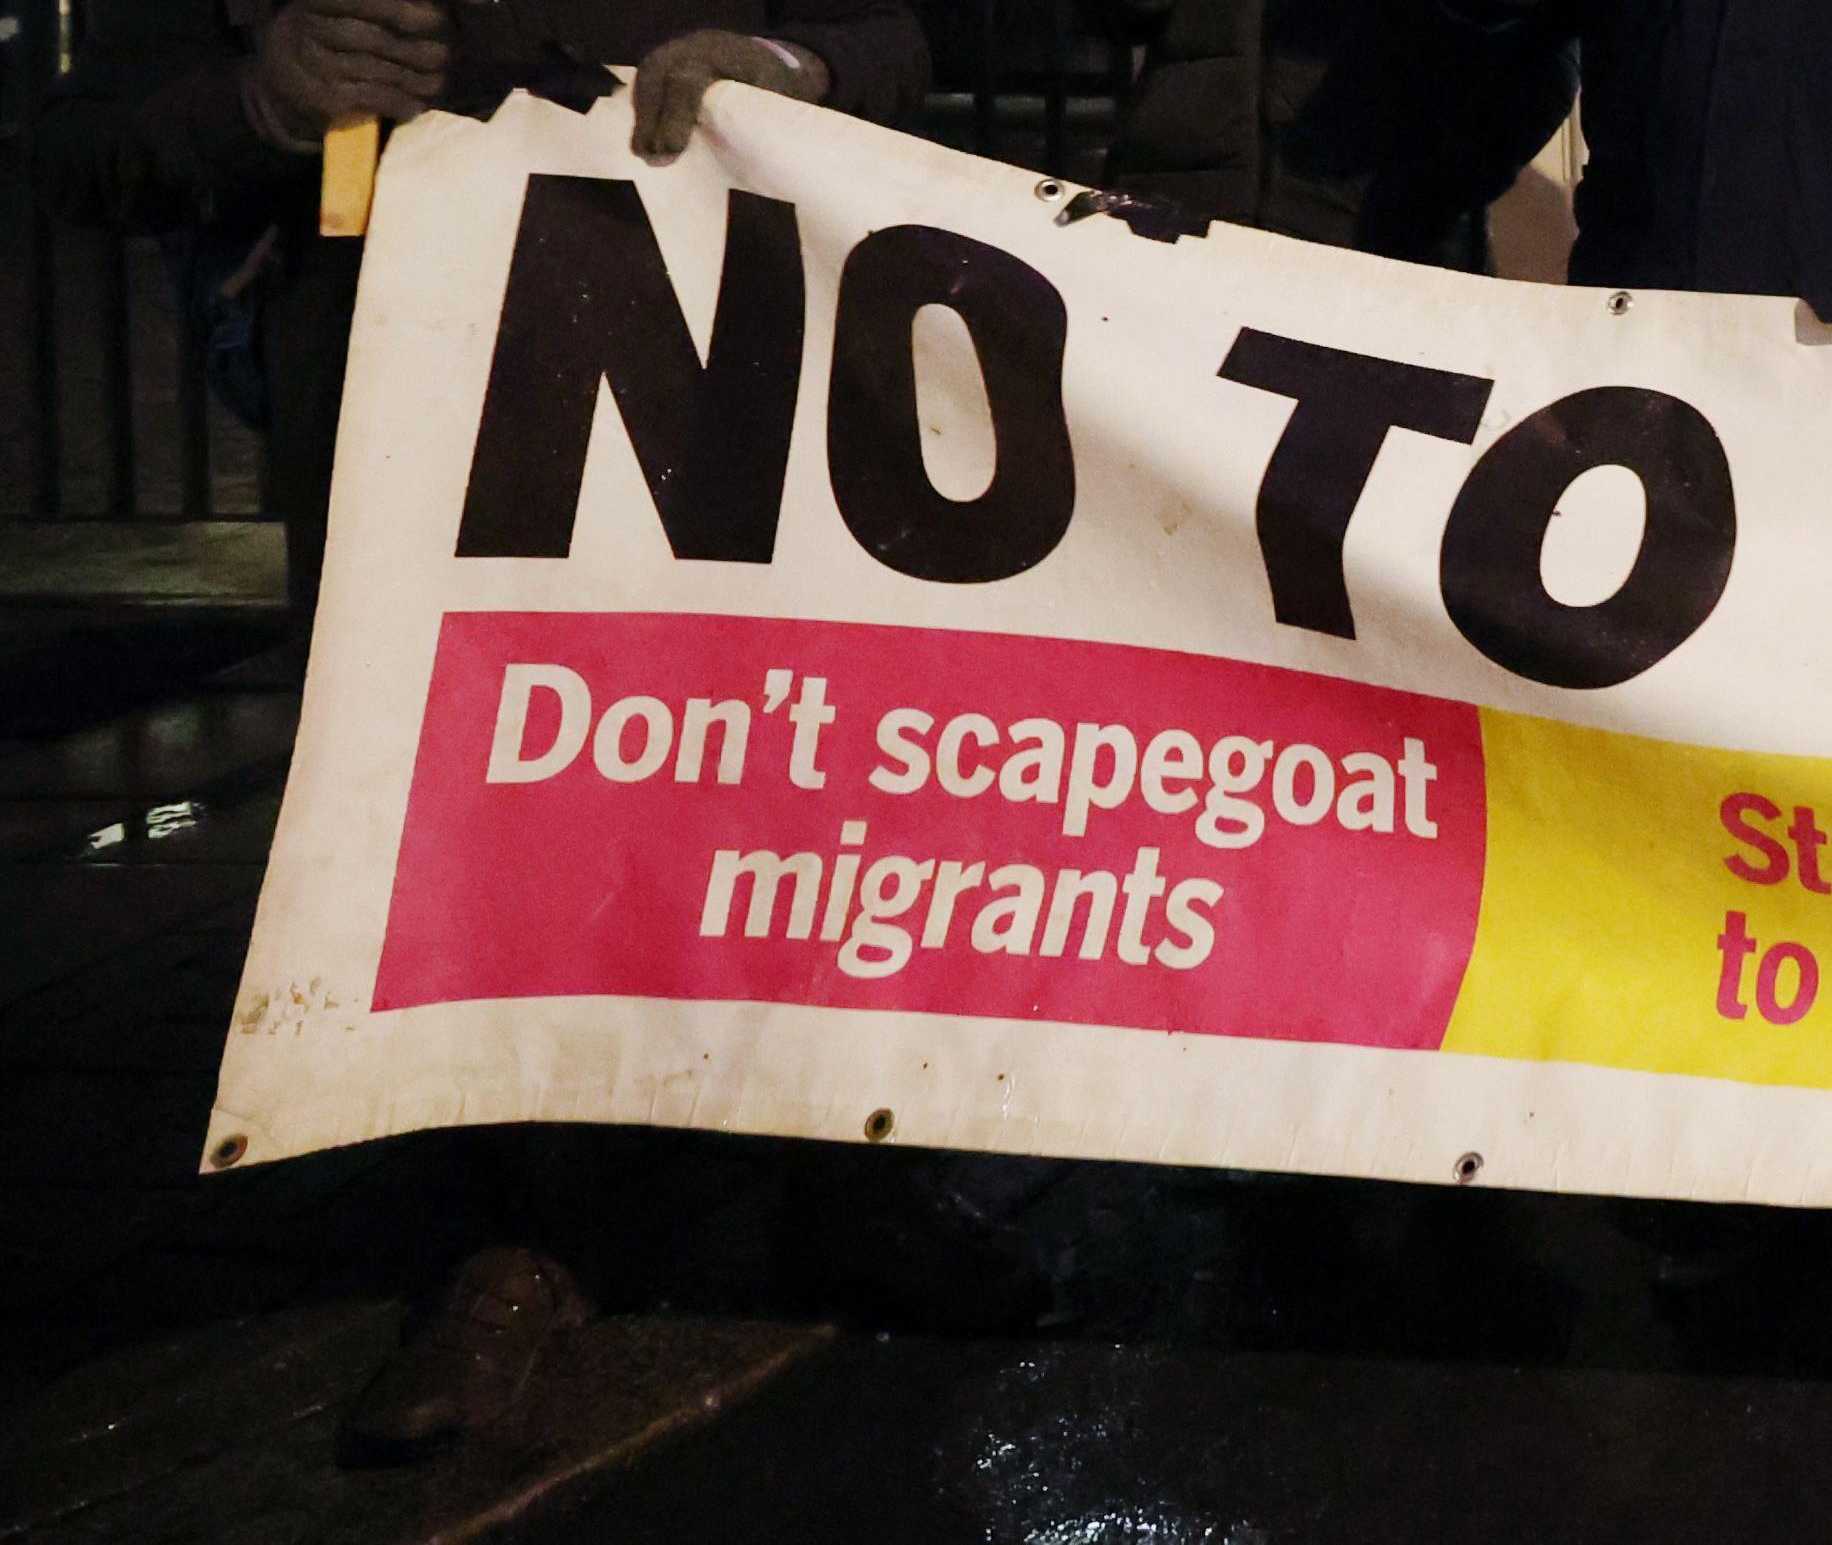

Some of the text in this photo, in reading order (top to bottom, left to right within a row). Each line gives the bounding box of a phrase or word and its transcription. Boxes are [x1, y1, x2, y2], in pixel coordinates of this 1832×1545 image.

[455, 172, 1076, 584] NO
[1216, 325, 1736, 690] TO
[485, 662, 1438, 851] Don't scapegoat
[699, 820, 1226, 980] migrants
[1715, 908, 1818, 1028] to
